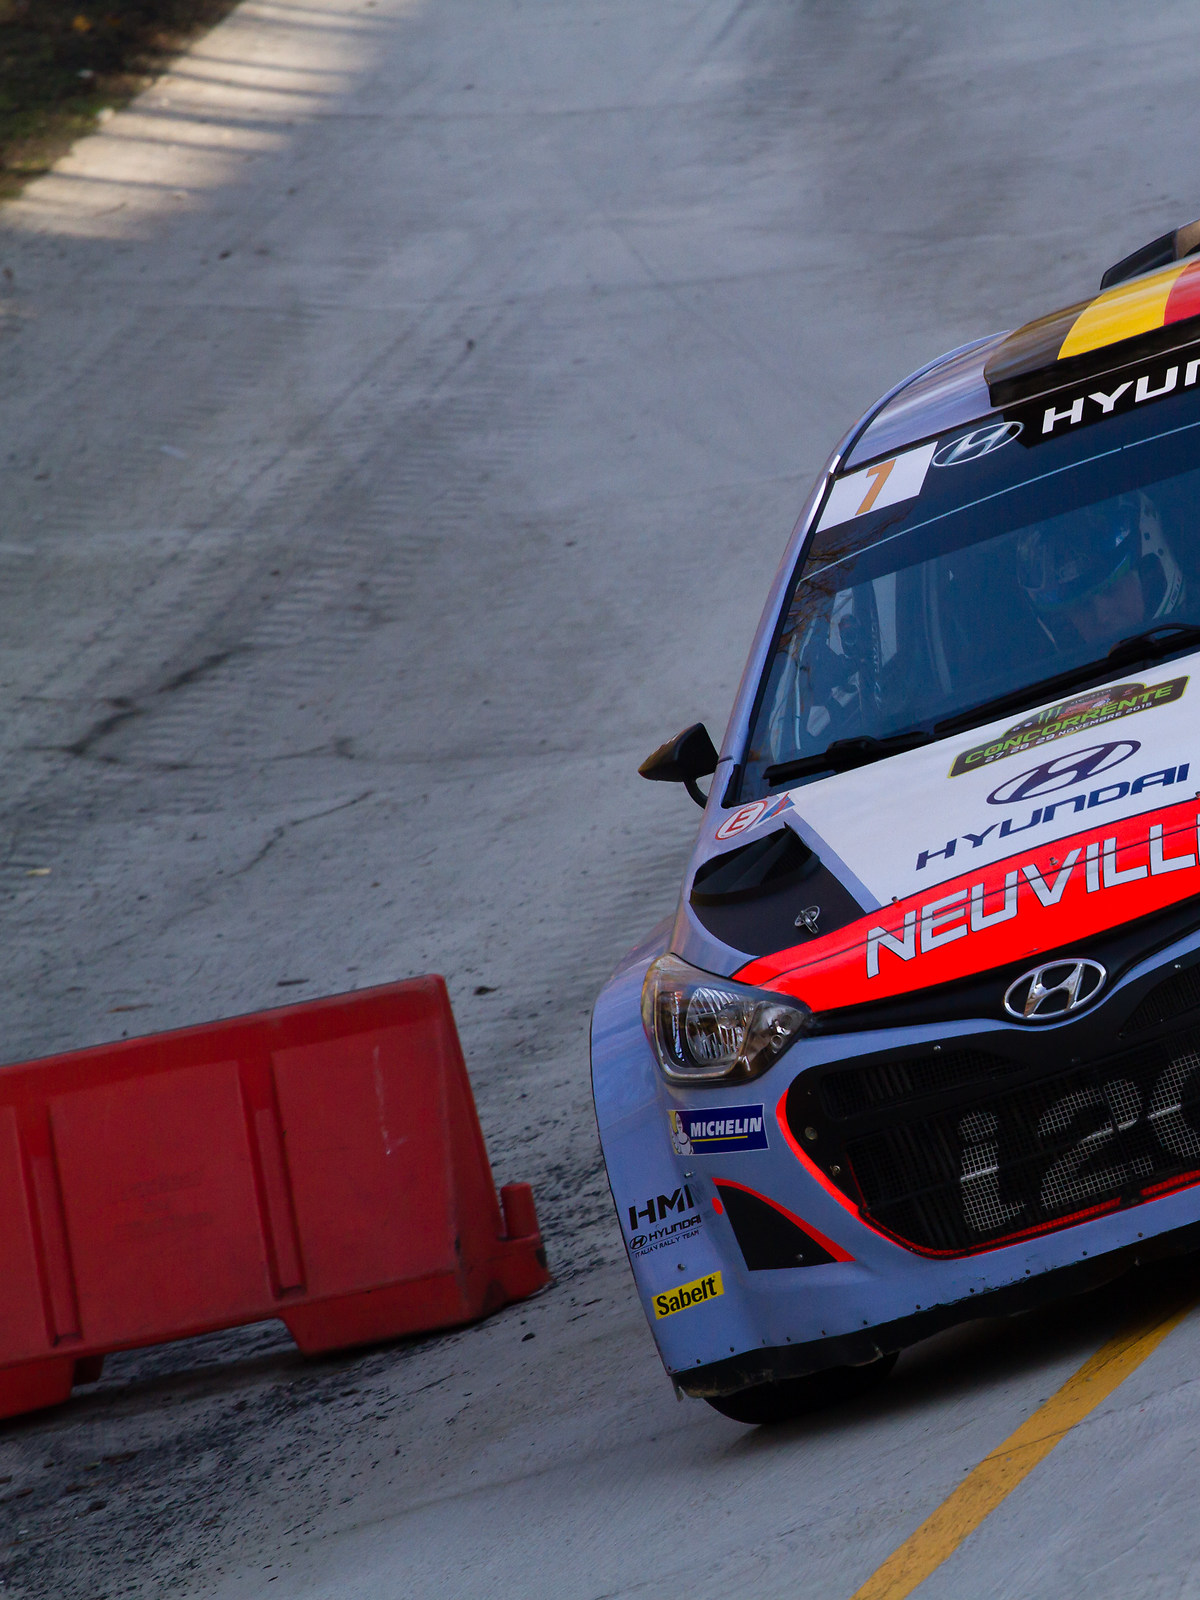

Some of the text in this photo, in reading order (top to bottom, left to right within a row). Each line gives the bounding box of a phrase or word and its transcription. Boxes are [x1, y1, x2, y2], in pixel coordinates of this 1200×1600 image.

[964, 685, 1174, 764] CONCORRENTE
[1059, 711, 1123, 736] NOVEMBRE
[725, 806, 758, 833] E
[915, 763, 1190, 871] HYUNDAI
[690, 1116, 762, 1138] MICHELIN
[628, 1184, 694, 1231] HMI
[649, 1214, 702, 1241] HYUNDAI
[660, 1237, 681, 1248] RALLY
[683, 1229, 700, 1240] TEAM
[656, 1276, 717, 1317] Sabelt
